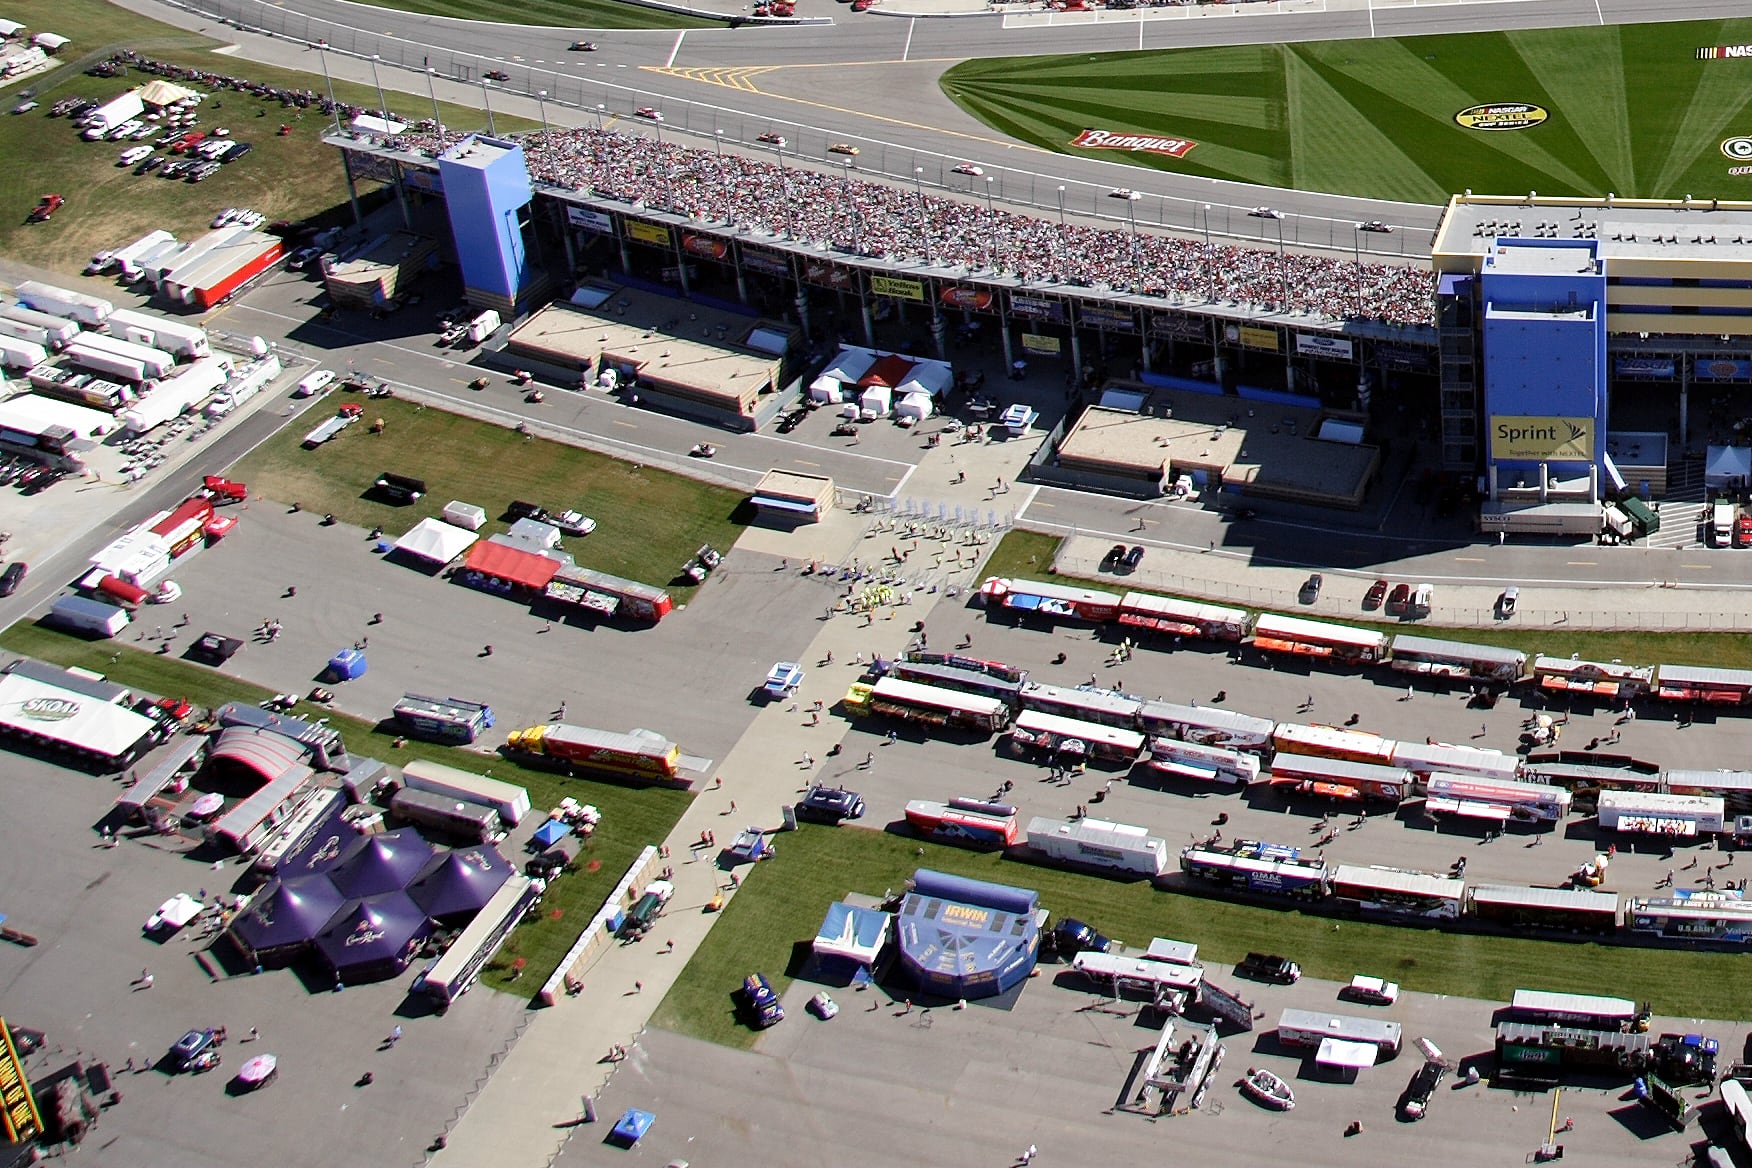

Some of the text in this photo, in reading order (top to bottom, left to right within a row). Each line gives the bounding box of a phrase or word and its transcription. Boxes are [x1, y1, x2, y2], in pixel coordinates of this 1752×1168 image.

[1473, 113, 1528, 122] NEXTEL
[1487, 106, 1528, 114] NASCAR
[1083, 130, 1186, 153] Banquet
[1498, 424, 1557, 443] Sprint
[24, 697, 81, 714] SKOAL
[945, 904, 988, 922] IRWIN
[5, 1085, 25, 1106] OF
[11, 1101, 33, 1130] ONE
